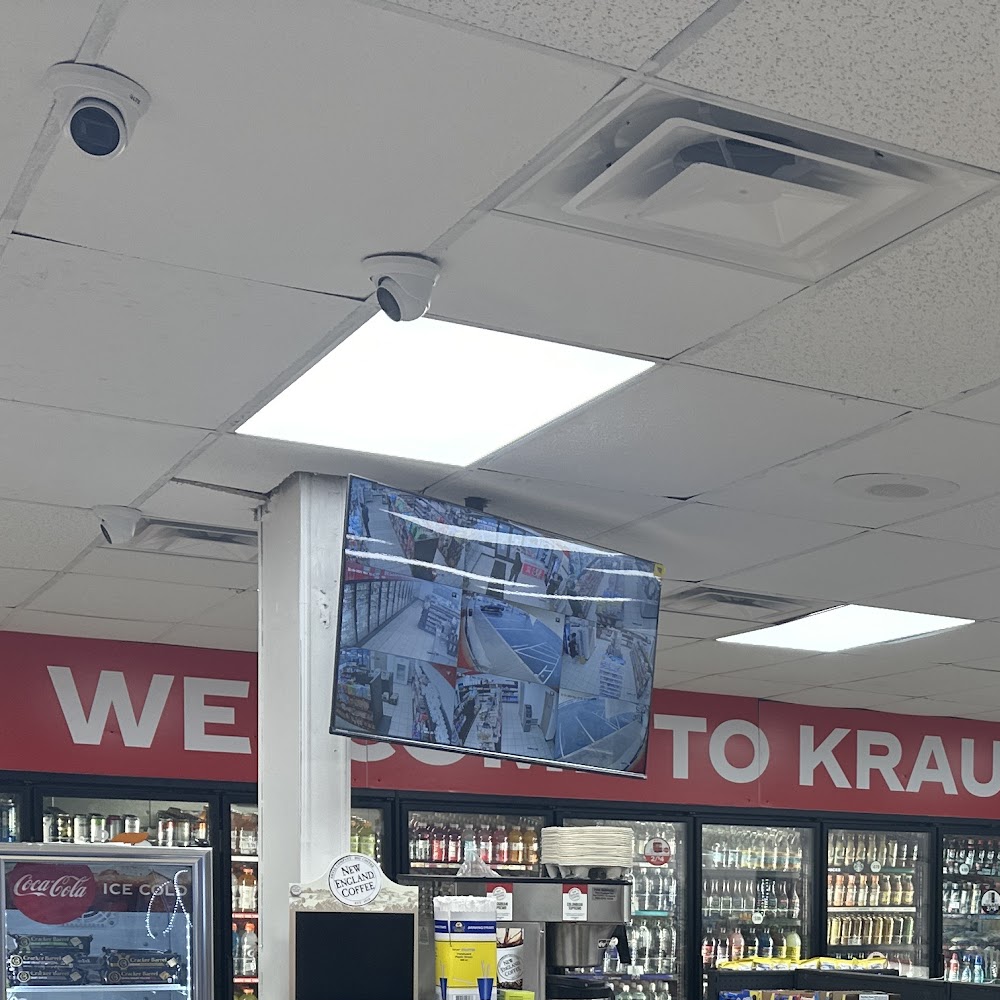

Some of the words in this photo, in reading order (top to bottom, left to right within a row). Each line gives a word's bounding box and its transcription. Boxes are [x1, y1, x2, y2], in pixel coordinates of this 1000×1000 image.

[653, 714, 770, 783] TO
[341, 864, 361, 876] NEW
[13, 874, 92, 898] Coca-Cola
[334, 871, 375, 889] ENGLAND
[103, 883, 133, 896] ICE
[139, 883, 188, 897] COLD
[341, 882, 375, 898] COFFEE
